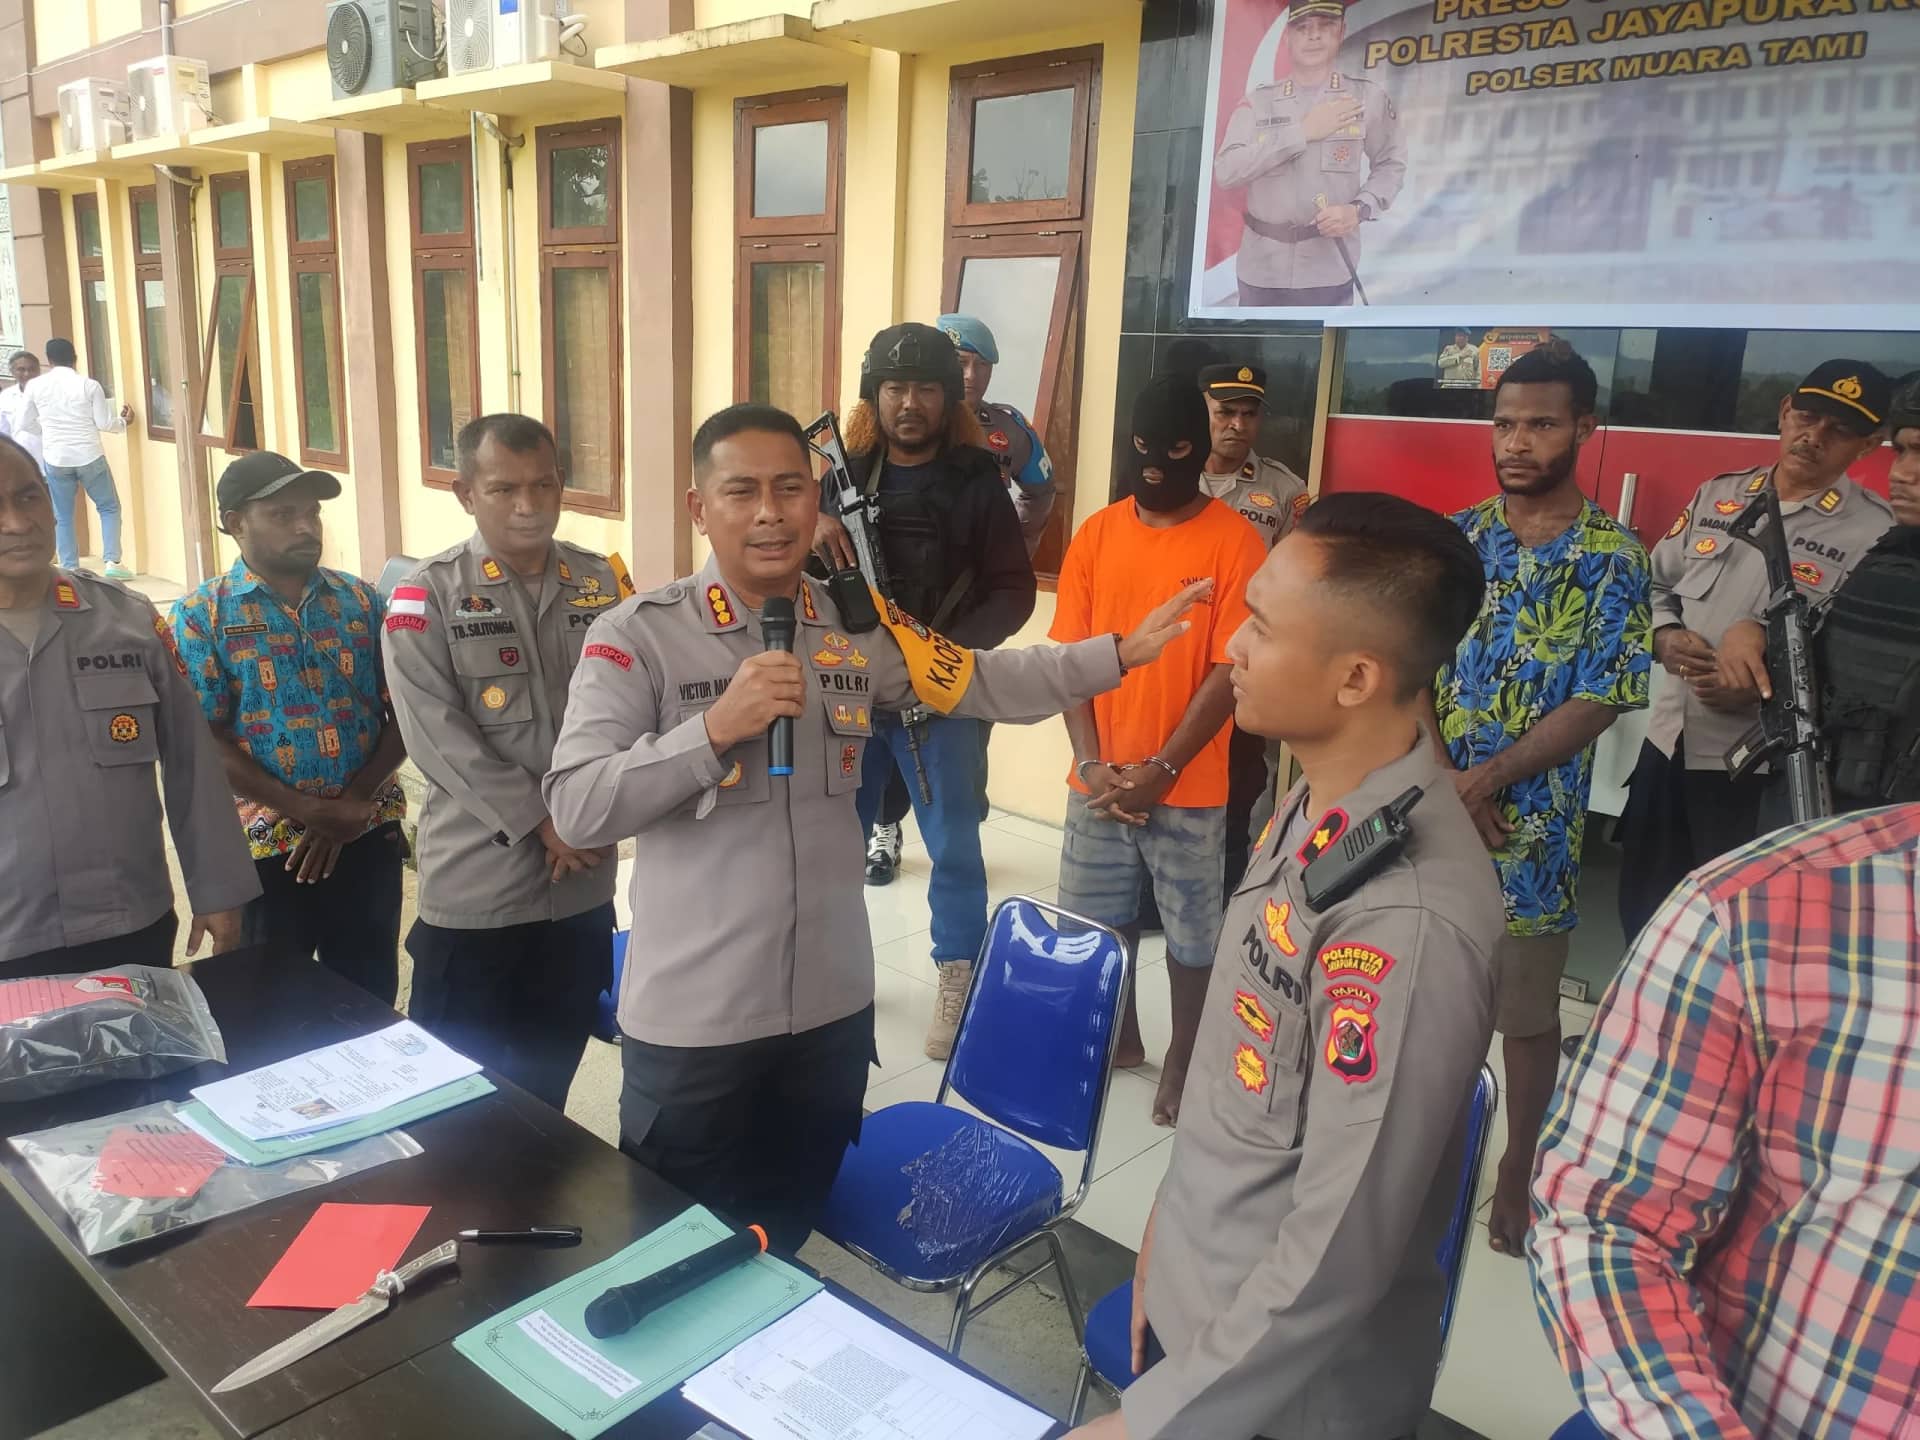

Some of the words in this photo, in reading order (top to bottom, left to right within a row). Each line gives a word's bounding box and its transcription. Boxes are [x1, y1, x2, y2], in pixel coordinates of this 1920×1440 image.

[1434, 0, 1568, 23] PRE
[1365, 17, 1578, 68] POLRESTA
[1466, 59, 1604, 95] POLSEK
[1609, 43, 1752, 81] MUARA
[1759, 31, 1868, 65] TAMI
[1240, 508, 1276, 528] POLRI
[1793, 537, 1846, 562] POLRI
[77, 653, 142, 671] POLRI
[587, 646, 630, 667] PELOPOR
[679, 681, 712, 700] VICTOR
[713, 677, 733, 697] MA
[819, 673, 869, 693] POLRI
[1243, 924, 1302, 1005] POLRI
[1322, 947, 1384, 970] POLRESTA
[1331, 986, 1372, 1003] PAPUA
